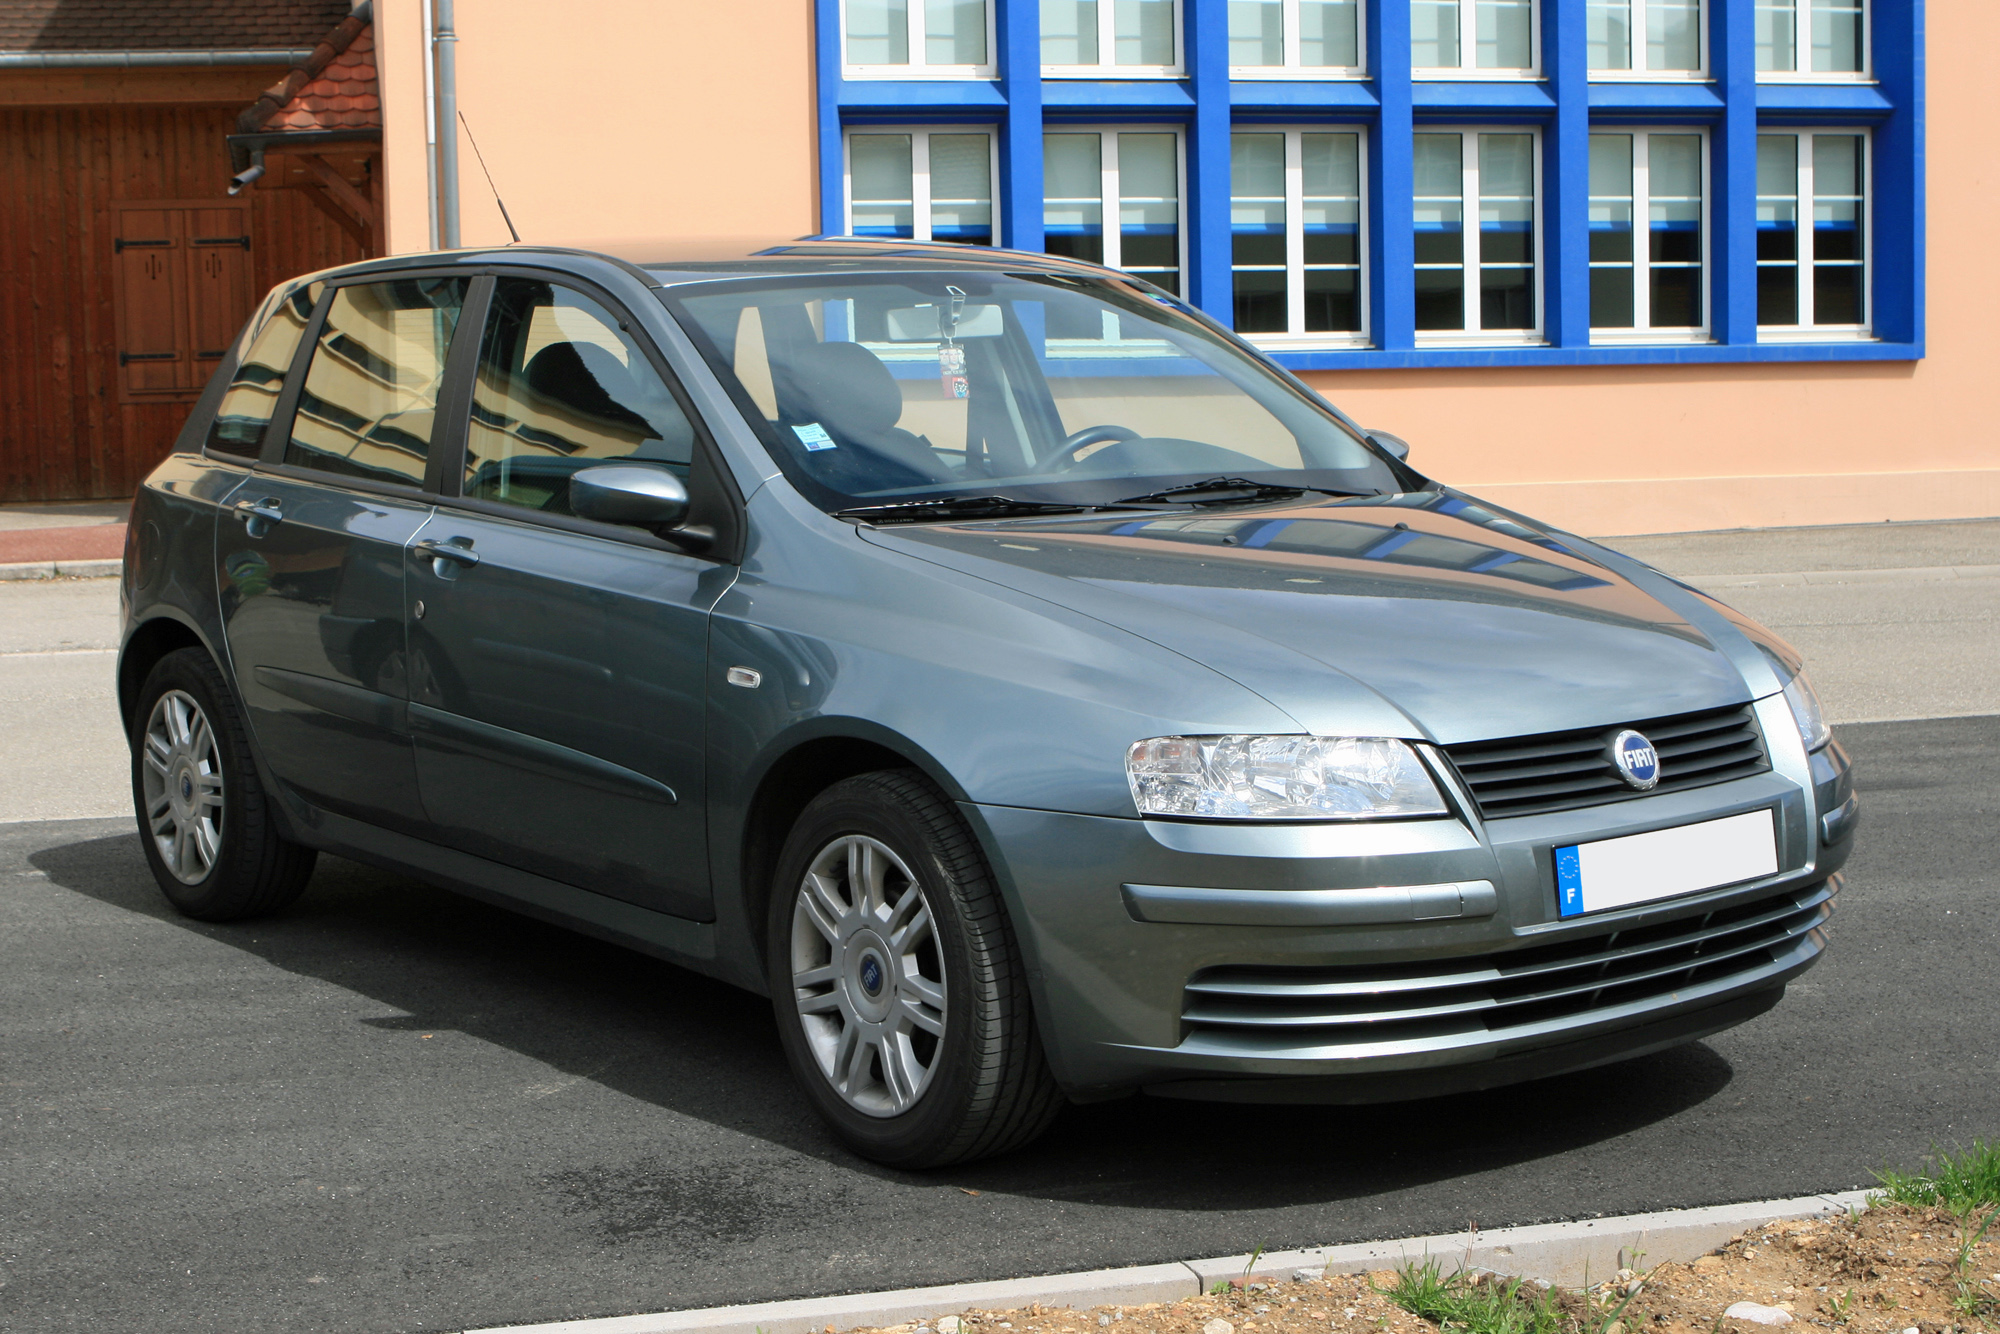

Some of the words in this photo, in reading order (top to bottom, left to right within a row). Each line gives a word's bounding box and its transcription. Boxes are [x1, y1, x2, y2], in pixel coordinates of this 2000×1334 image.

[1623, 747, 1653, 770] FIAT
[1566, 888, 1576, 904] F
[863, 963, 878, 987] FIAT
